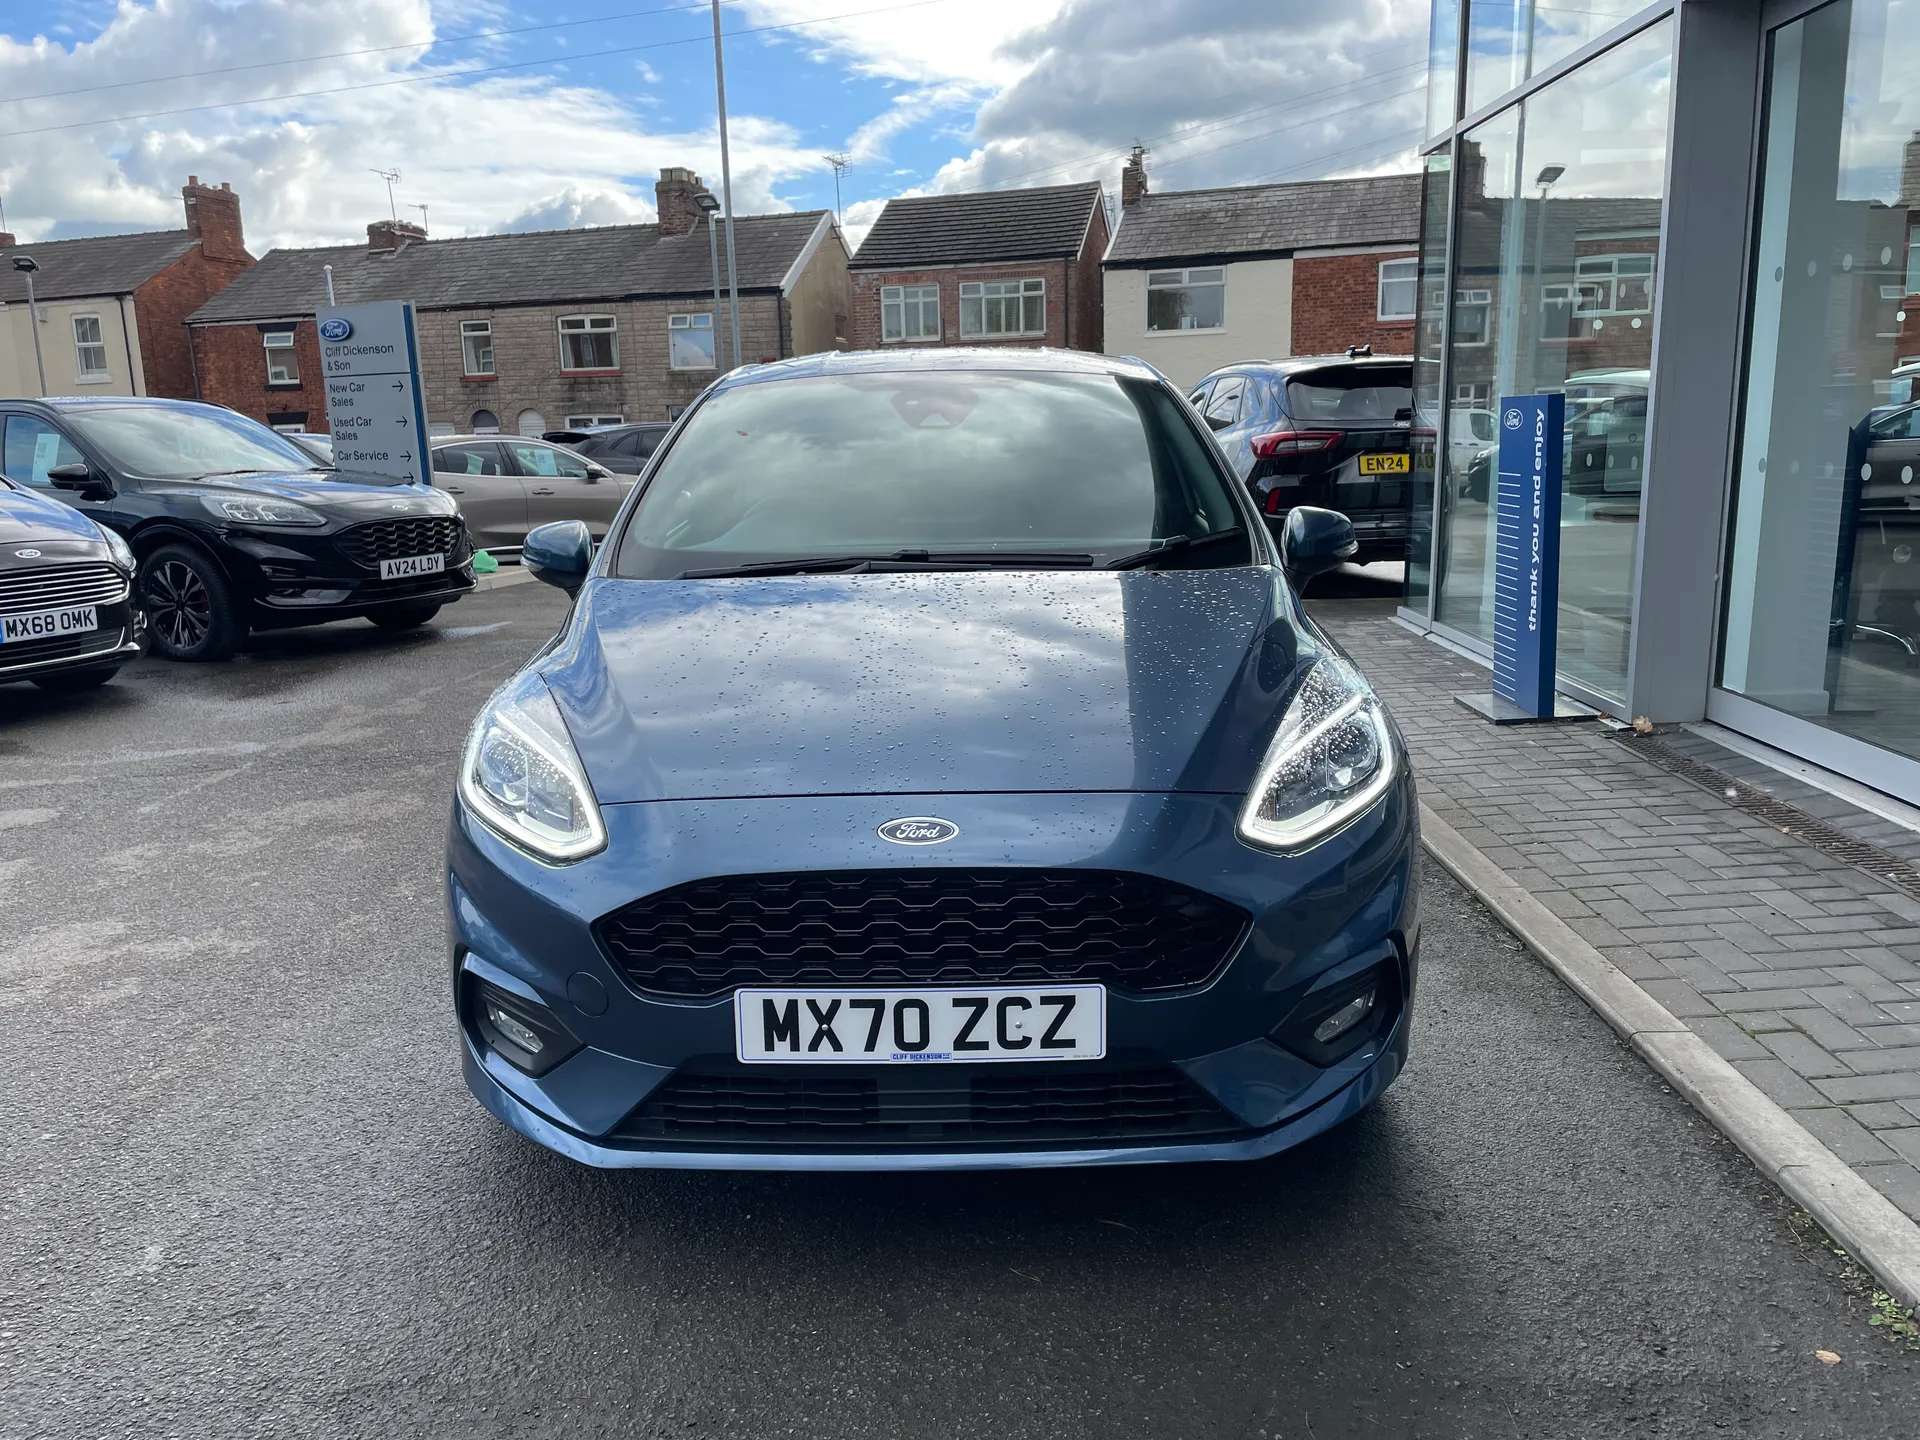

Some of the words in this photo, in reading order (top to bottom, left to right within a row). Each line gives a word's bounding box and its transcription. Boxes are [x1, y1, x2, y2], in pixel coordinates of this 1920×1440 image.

[325, 322, 344, 337] Ford
[325, 346, 341, 358] Cliff
[342, 343, 394, 357] Dickenson
[327, 362, 333, 371] &
[334, 360, 351, 371] Son
[329, 383, 348, 394] New
[349, 382, 365, 393] Car
[331, 396, 354, 408] Sales
[333, 417, 354, 428] Used
[355, 416, 372, 427] Car
[335, 430, 358, 441] Sales
[1534, 408, 1545, 471] enjoy
[337, 450, 352, 461] Car
[353, 450, 389, 461] Service
[1366, 457, 1404, 472] EN24
[1532, 475, 1542, 519] and
[1531, 523, 1541, 564] you
[387, 560, 417, 576] AV24
[420, 556, 440, 572] LDY
[1528, 568, 1539, 632] thank
[5, 615, 55, 637] MX68
[60, 609, 94, 630] OMK
[896, 822, 941, 839] Ford
[762, 997, 930, 1053] MX70
[951, 994, 1077, 1051] ZCZ
